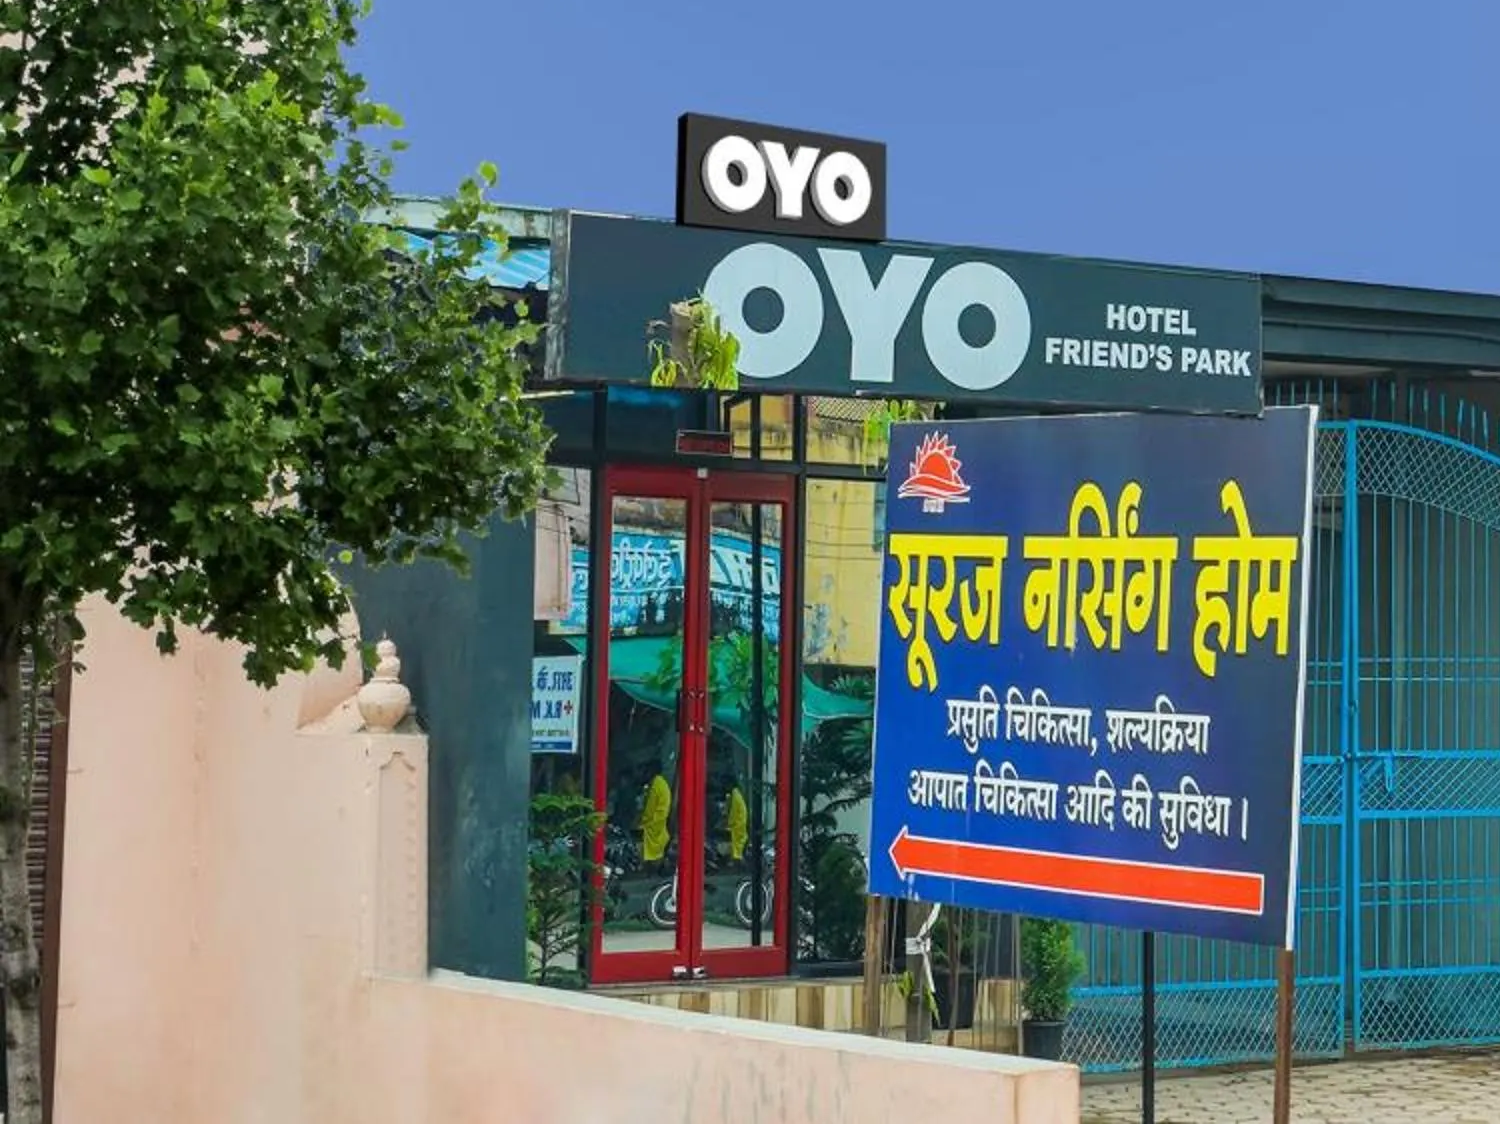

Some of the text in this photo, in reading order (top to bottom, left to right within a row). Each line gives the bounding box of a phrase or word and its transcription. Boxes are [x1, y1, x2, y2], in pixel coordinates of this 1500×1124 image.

[701, 135, 872, 225] OYO
[702, 242, 1032, 390] OYO
[1045, 337, 1251, 376] FRIEND'S PARK
[1106, 303, 1196, 336] HOTEL
[889, 479, 1298, 693] सूरज नर्सिंग होम
[946, 684, 1211, 756] प्रसुति चिकित्सा, शल्यक्रिया
[908, 769, 968, 812] आपात
[974, 759, 1058, 820] चिकित्सा
[1065, 769, 1115, 830] आदि
[1122, 774, 1152, 829] की
[1158, 776, 1231, 850] सुविधा
